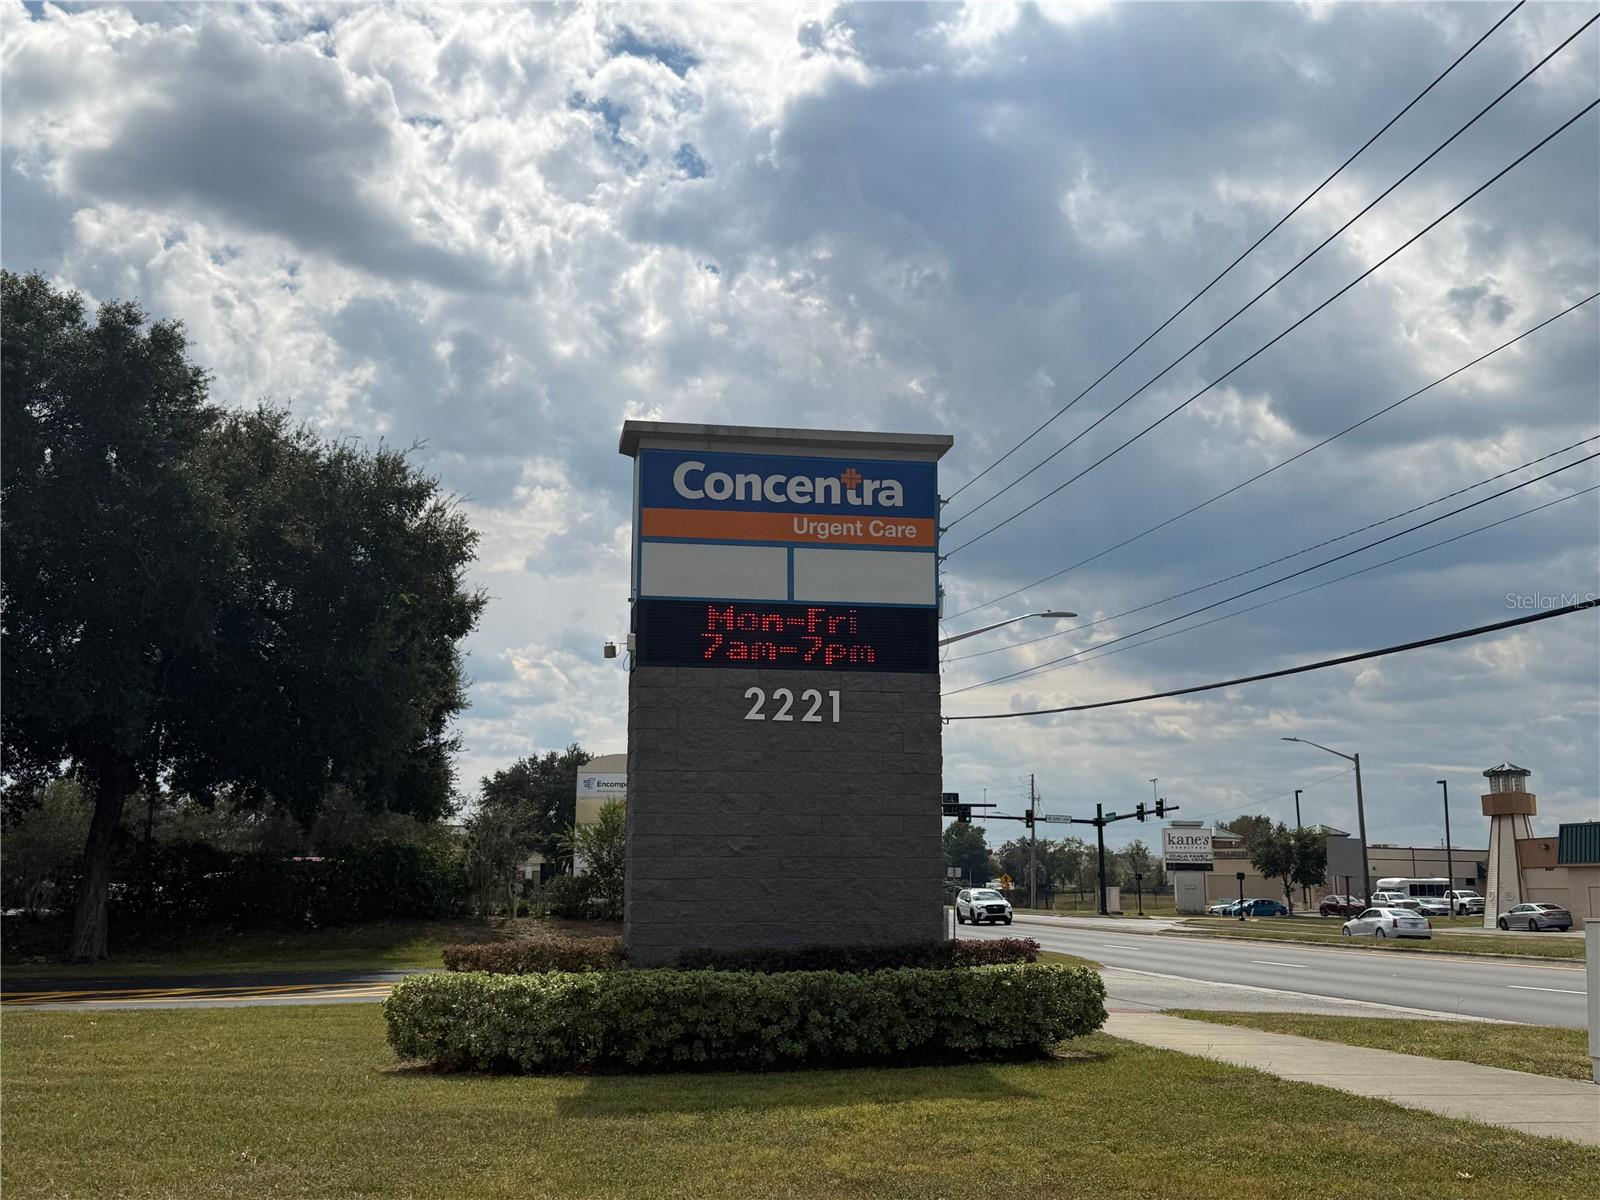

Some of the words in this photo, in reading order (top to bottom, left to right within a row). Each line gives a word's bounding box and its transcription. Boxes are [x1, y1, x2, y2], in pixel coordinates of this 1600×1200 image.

[672, 460, 904, 507] Concentra
[793, 517, 863, 539] Urgent
[868, 520, 917, 538] Care
[708, 605, 857, 634] Mon-Fri
[701, 633, 876, 665] 7am-7pm
[743, 686, 840, 723] 2221
